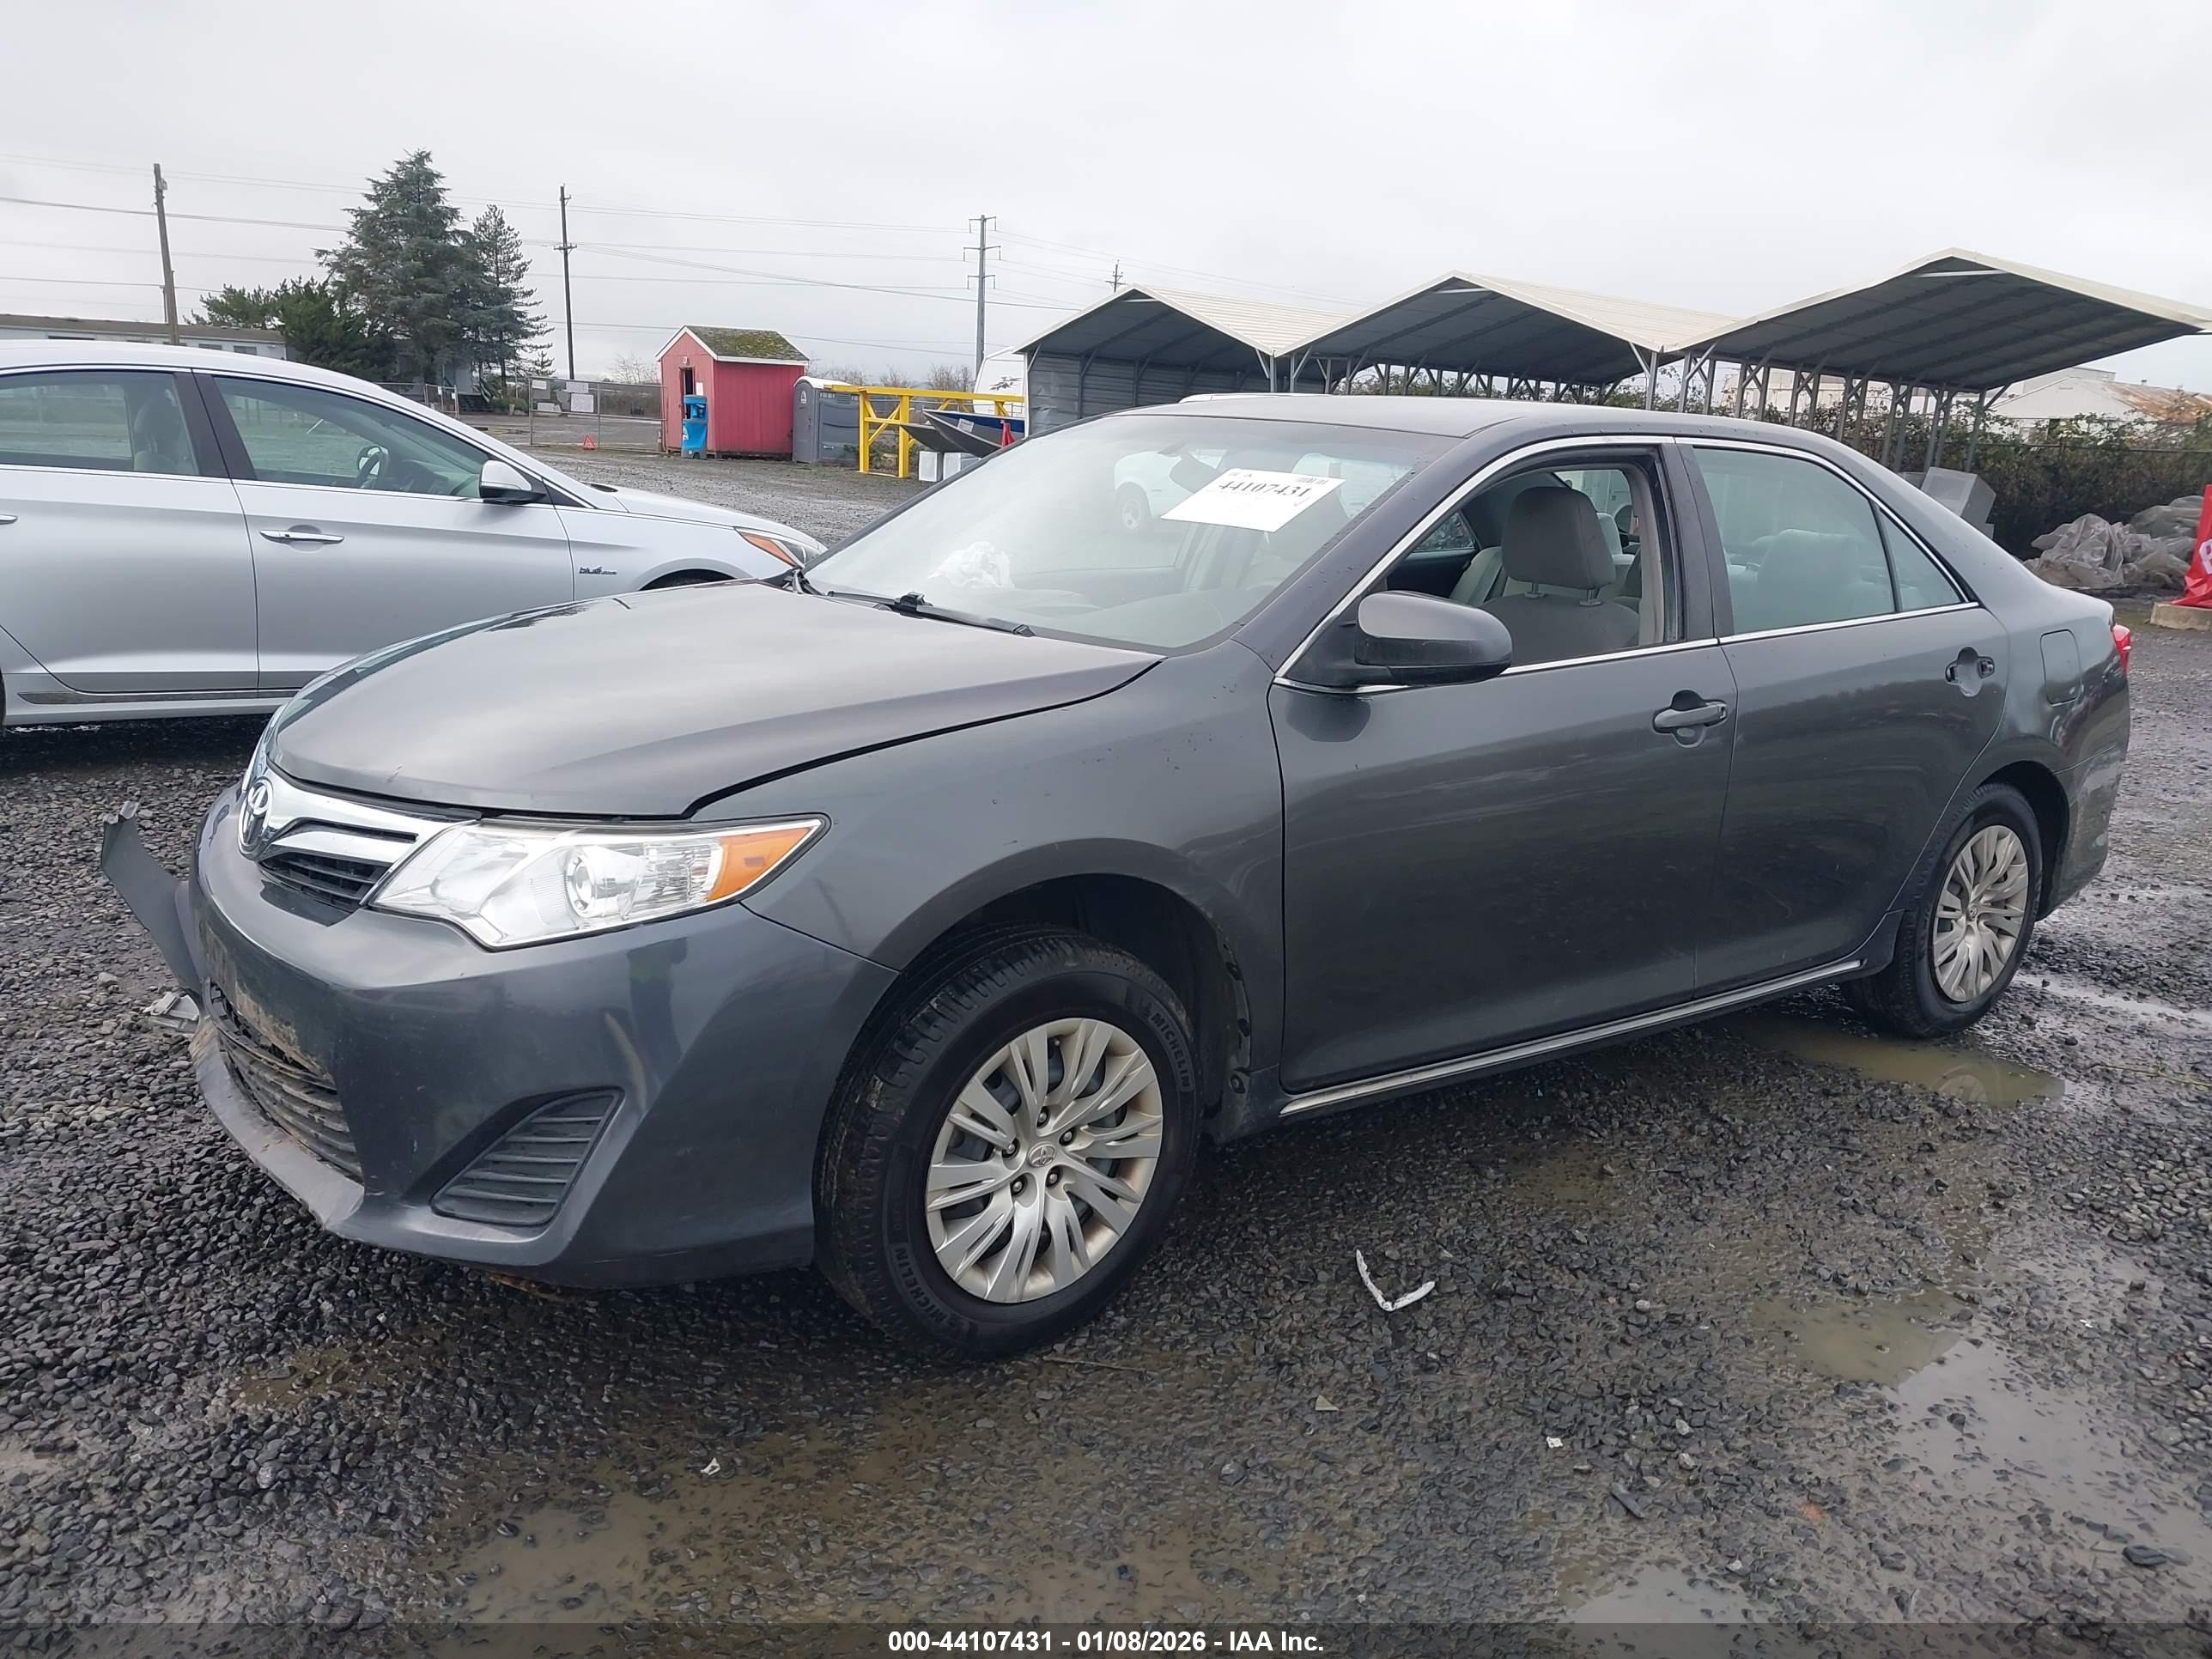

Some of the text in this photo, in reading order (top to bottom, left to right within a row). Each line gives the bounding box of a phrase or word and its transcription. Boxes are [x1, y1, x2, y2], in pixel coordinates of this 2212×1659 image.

[1218, 480, 1312, 497] 44107431
[1151, 1012, 1191, 1088] MICHELIN
[894, 1247, 948, 1322] MICHELIN
